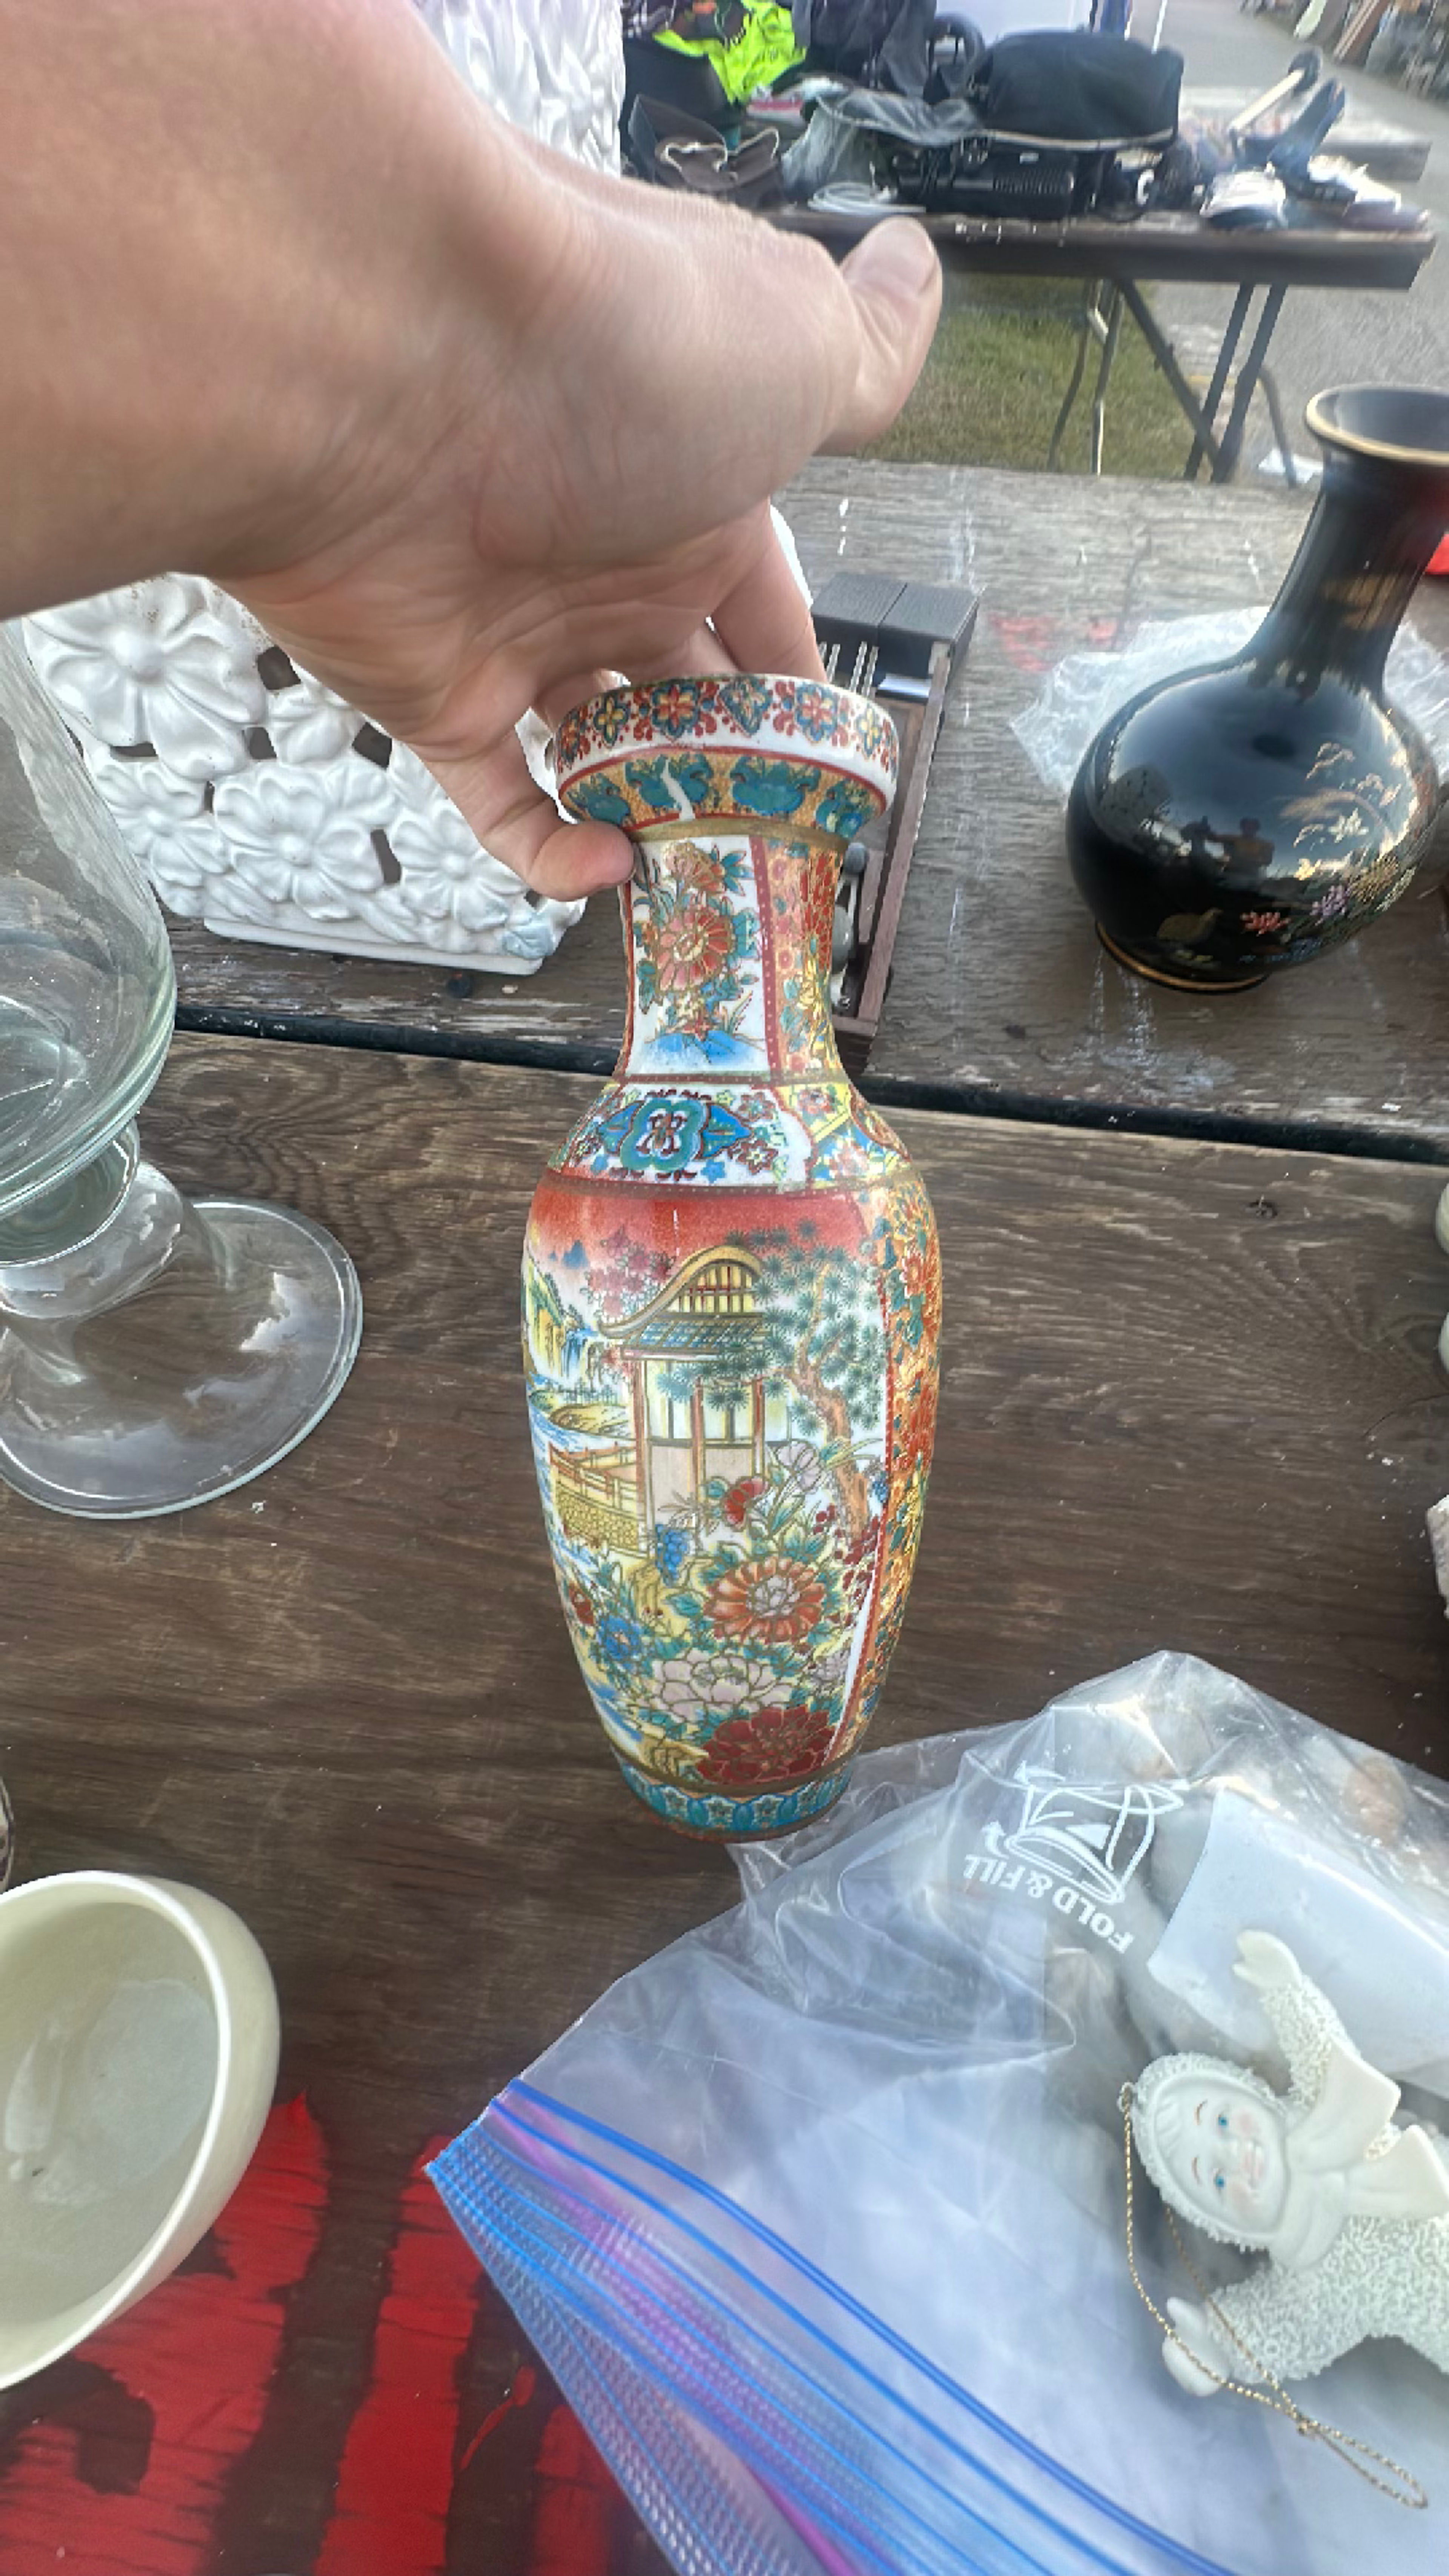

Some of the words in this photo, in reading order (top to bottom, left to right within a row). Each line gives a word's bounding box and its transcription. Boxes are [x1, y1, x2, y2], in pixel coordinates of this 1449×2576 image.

[963, 1854, 1025, 1890] FILL
[1025, 1870, 1053, 1898] &
[1052, 1887, 1134, 1953] FOLD
